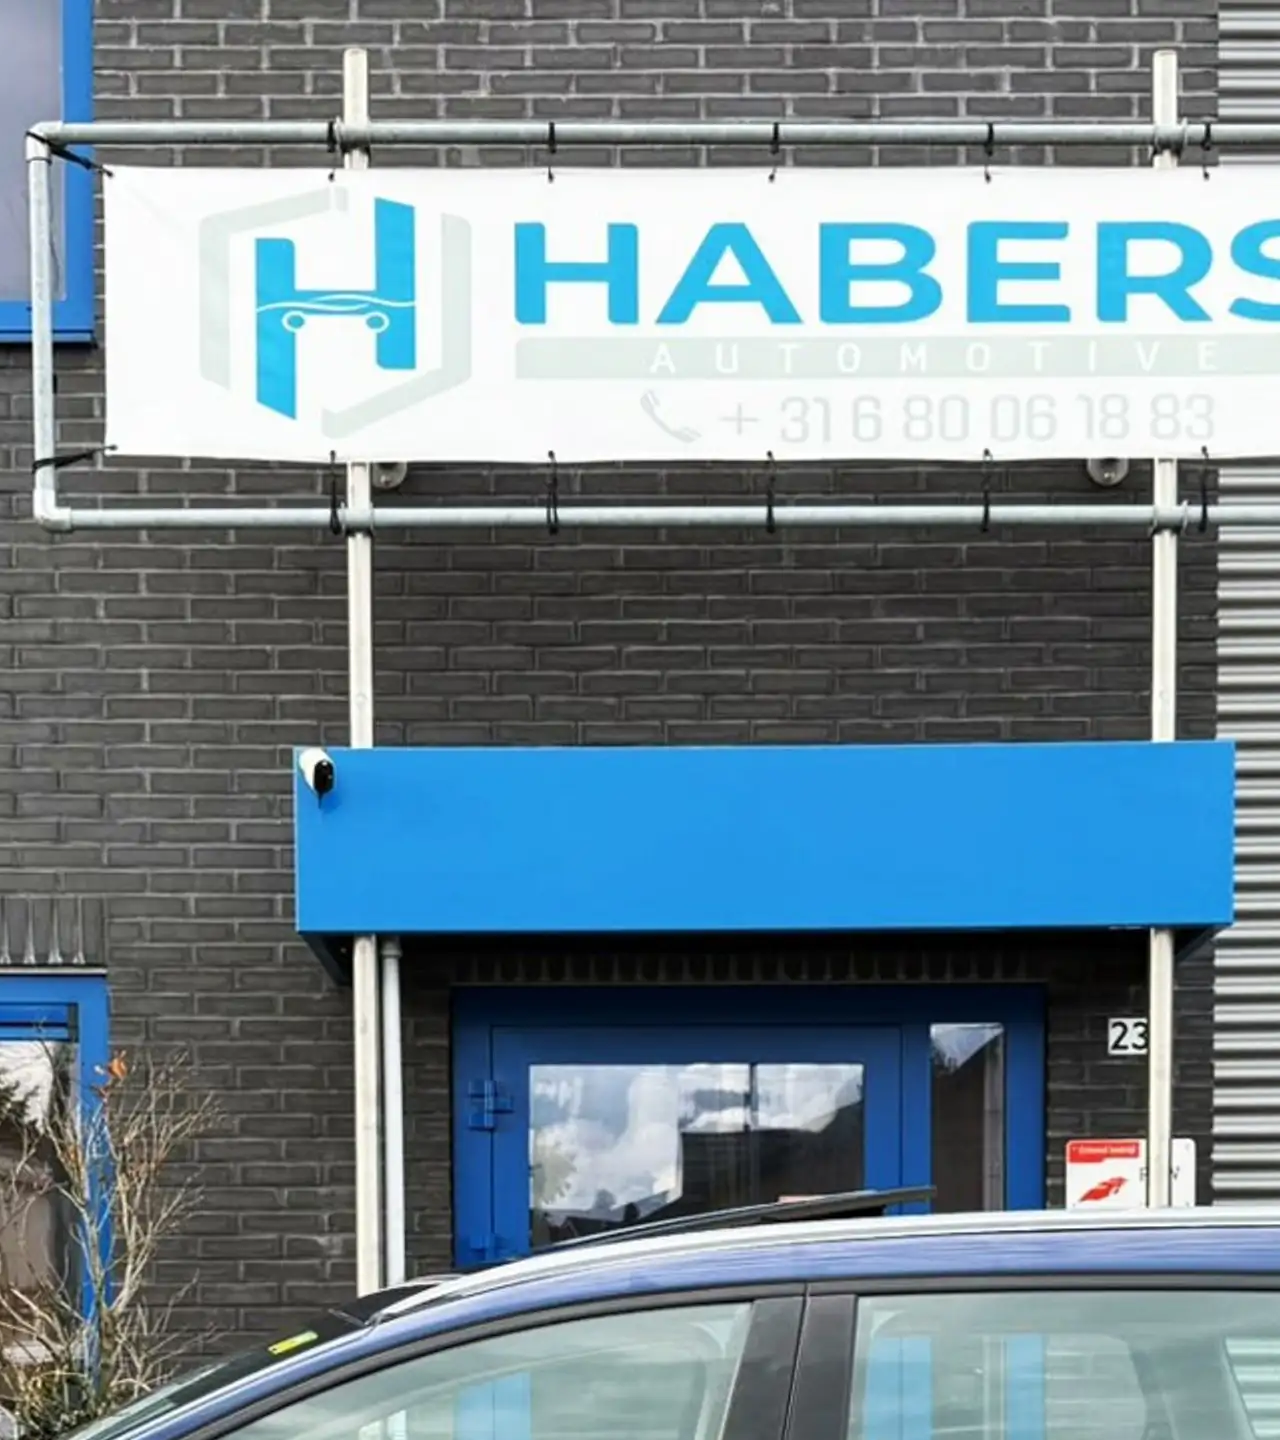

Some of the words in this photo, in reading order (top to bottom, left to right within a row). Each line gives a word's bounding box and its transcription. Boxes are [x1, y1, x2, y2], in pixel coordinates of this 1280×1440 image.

[649, 339, 1219, 374] AUTOMOTIVE
[851, 394, 883, 442] 6
[902, 394, 970, 442] 80
[989, 394, 1058, 441] 06
[1075, 393, 1130, 440] 18
[1149, 393, 1216, 439] 83
[1110, 1020, 1148, 1051] 23
